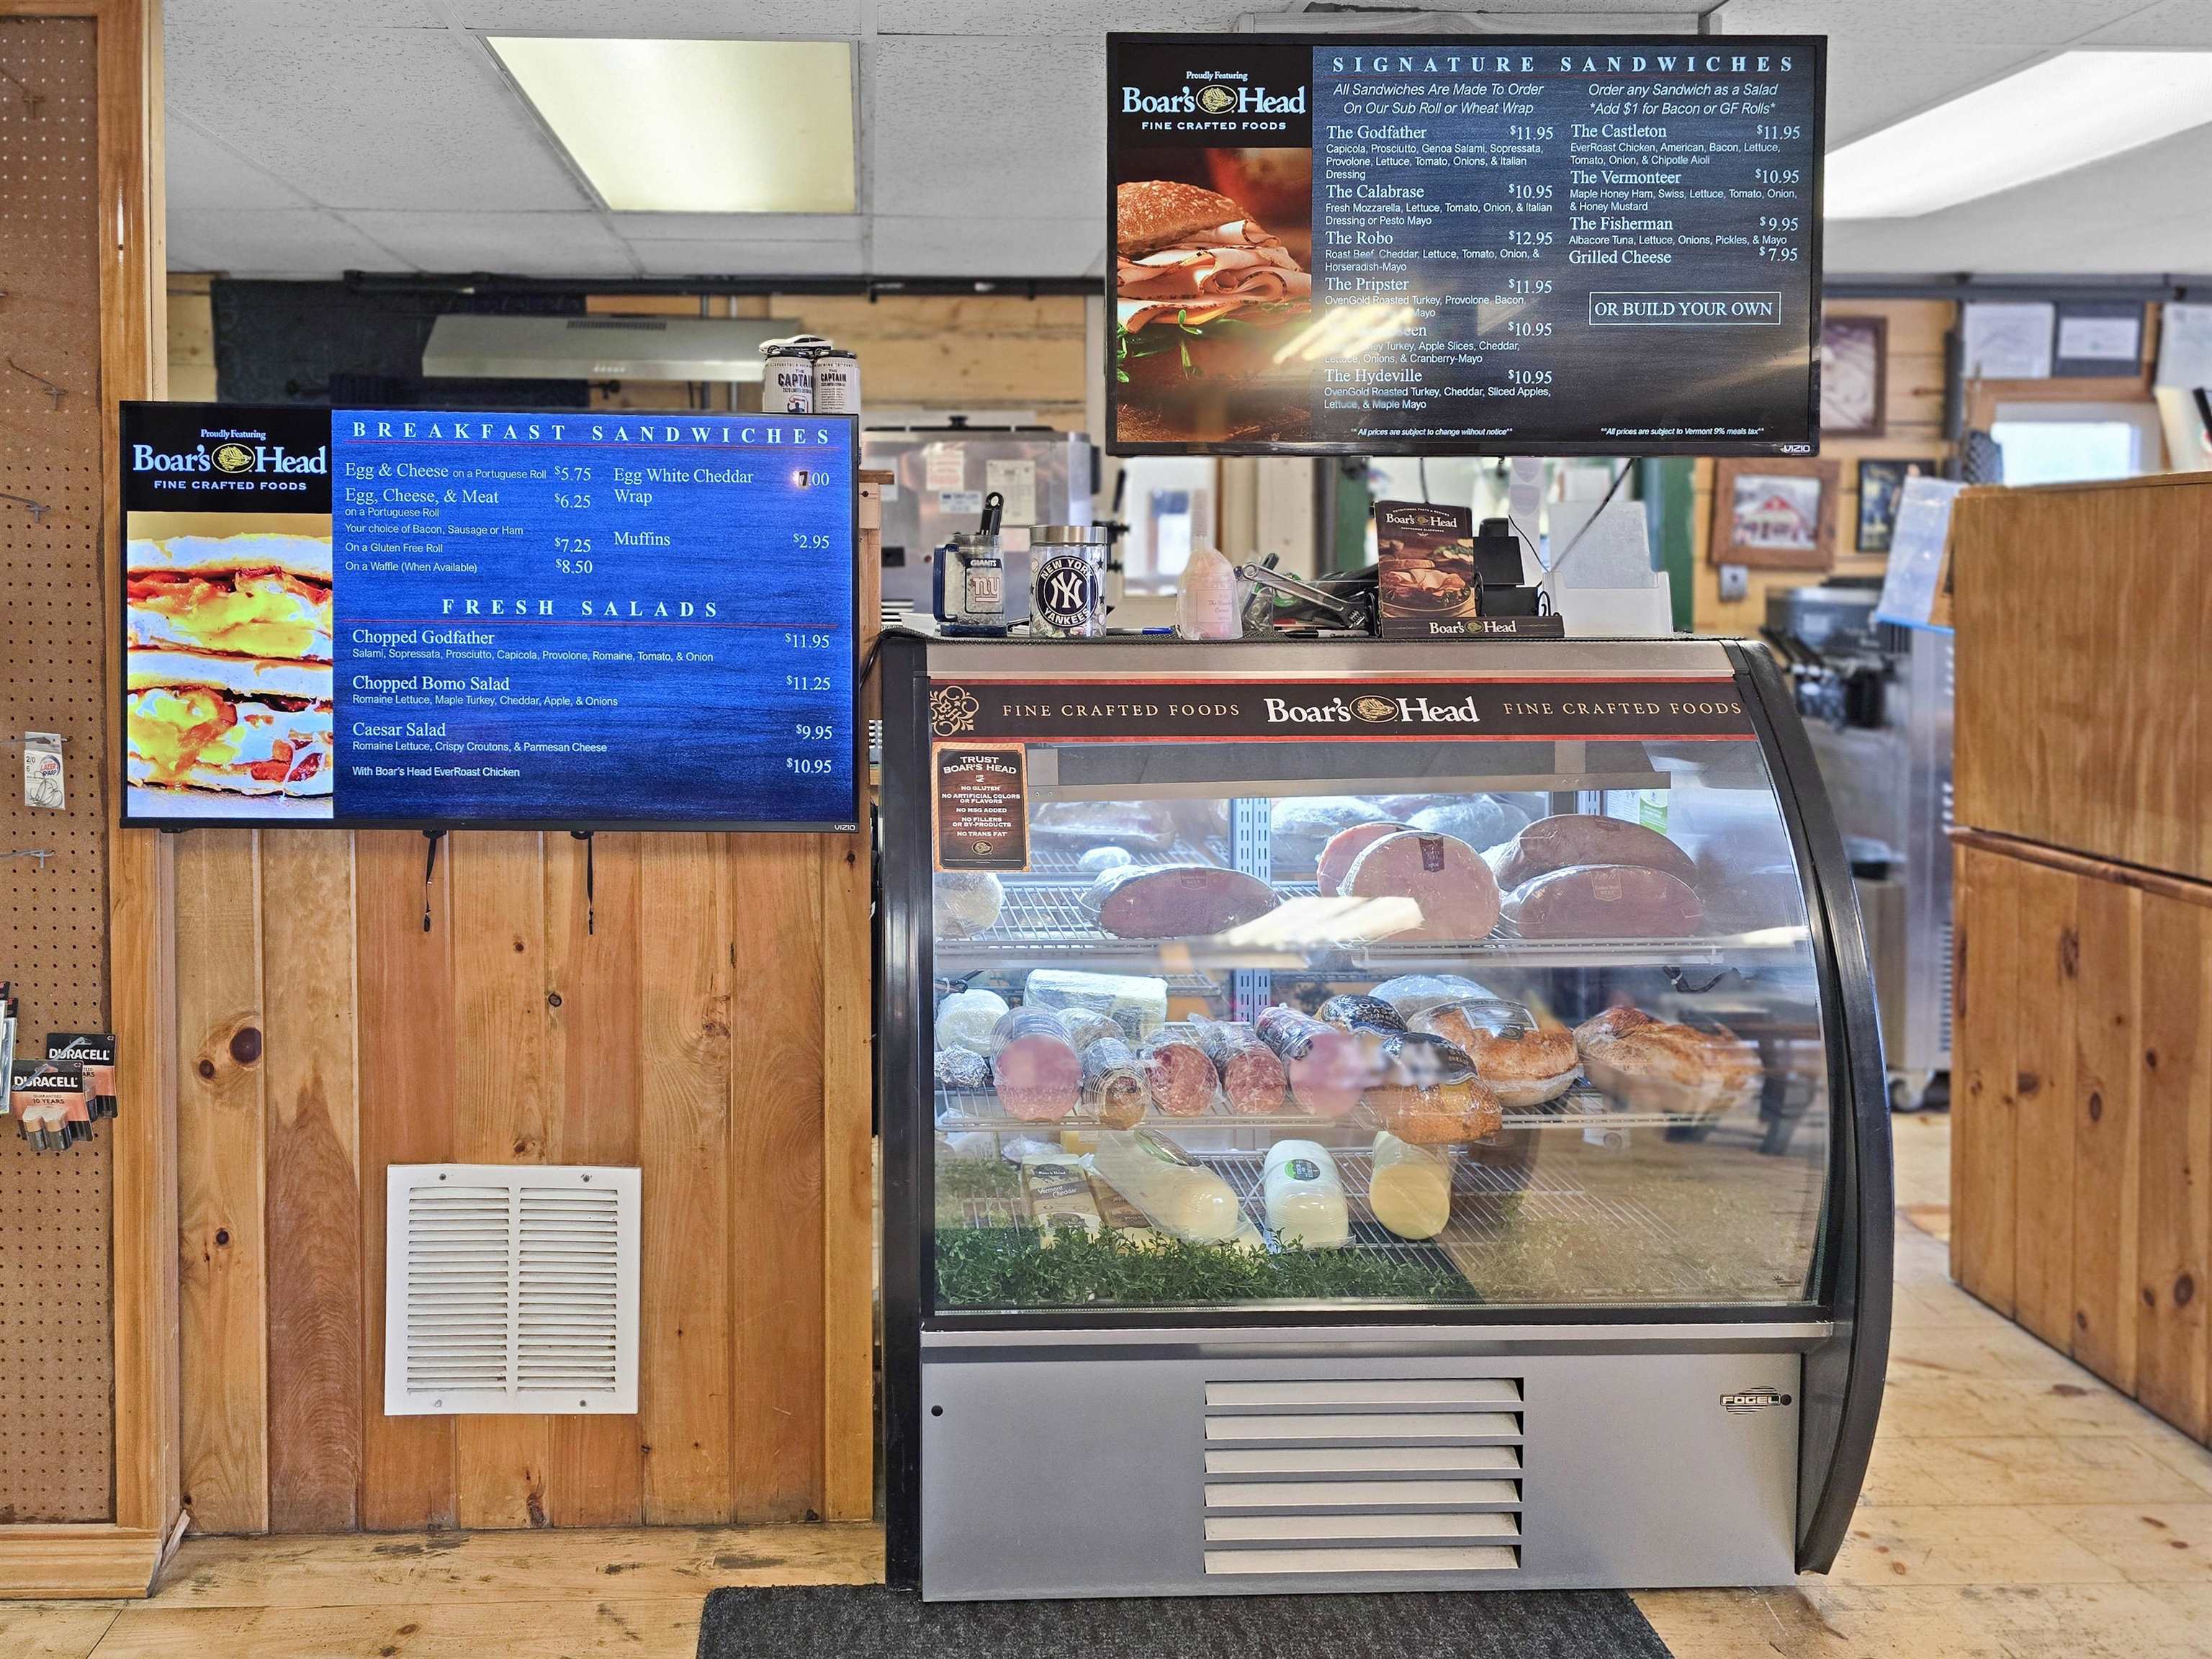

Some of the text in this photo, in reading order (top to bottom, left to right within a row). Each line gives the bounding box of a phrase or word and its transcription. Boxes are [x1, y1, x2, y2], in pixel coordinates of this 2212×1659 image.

[1332, 56, 1791, 72] SIGNATURE SANDWICHES
[1186, 71, 1248, 82] Proudly Featuring
[1333, 84, 1545, 95] All Sandwiches Are Made To Order
[1588, 84, 1779, 98] Order any Sandwich as a Salad
[1122, 86, 1306, 114] Boar's Head
[1344, 102, 1534, 117] On Our Sub Roll or Wheat Wrap
[1141, 122, 1286, 130] FINE CRAFTED FOODS
[1326, 125, 1553, 140] The Godfather $11.95
[1570, 124, 1801, 140] The Castleton $11.95
[1326, 144, 1543, 155] Capicola, Prosciutto, Genoa Salami, Sopressata,
[1570, 168, 1799, 184] The Vermonteer $10.95
[1326, 184, 1552, 199] The Calabrase $10.95
[1570, 217, 1596, 230] The
[1600, 217, 1673, 230] Fisherman
[1326, 230, 1553, 246] The Robo $12.95
[1568, 250, 1618, 264] Grilled
[1622, 250, 1672, 264] Cheese
[1325, 277, 1552, 295] The Pripster $11.95
[1594, 302, 1773, 316] OR BUILD YOUR OWN
[1325, 369, 1552, 385] The Hydeville $10.95
[200, 430, 266, 441] Proudly Featuring
[353, 421, 828, 444] BREAKFAST SANDWICHES
[1784, 444, 1810, 453] VIZIO
[133, 444, 327, 474] Boar's Head
[346, 462, 374, 480] Egg
[379, 462, 392, 477] &
[397, 463, 449, 477] Cheese
[476, 470, 527, 480] Portuguese
[530, 470, 547, 480] Roll
[554, 466, 591, 482] $5.75
[613, 468, 754, 485] Egg White Cheddar
[153, 480, 307, 490] FINE CRAFTED FOODS
[346, 488, 590, 509] Egg, Cheese, & Meat $6.25
[614, 489, 652, 505] Wrap
[1386, 513, 1457, 528] Boar's Head
[614, 531, 830, 549] Muffins $2.95
[1040, 559, 1093, 580] NEW YORK
[442, 599, 717, 618] FRESH SALADS
[1044, 606, 1091, 625] YANKEES
[1429, 620, 1517, 634] Boar's Head
[352, 629, 830, 649] Chopped Godfather $11.95
[352, 675, 830, 693] Chopped Bomo Salad $11.25
[1002, 703, 1241, 717] FINE CRAFTED FOODS
[1264, 696, 1480, 723] Boar's Head
[1503, 702, 1743, 715] FINE CRAFTED FOODS
[352, 722, 833, 739] Caesar Salad $9.95
[352, 758, 832, 777] With Boar's Head EverRoast Chicken $10.95
[943, 763, 1017, 774] BOAR'S HEAD
[49, 1048, 109, 1061] DURACELL
[14, 1076, 78, 1088] DURACELL
